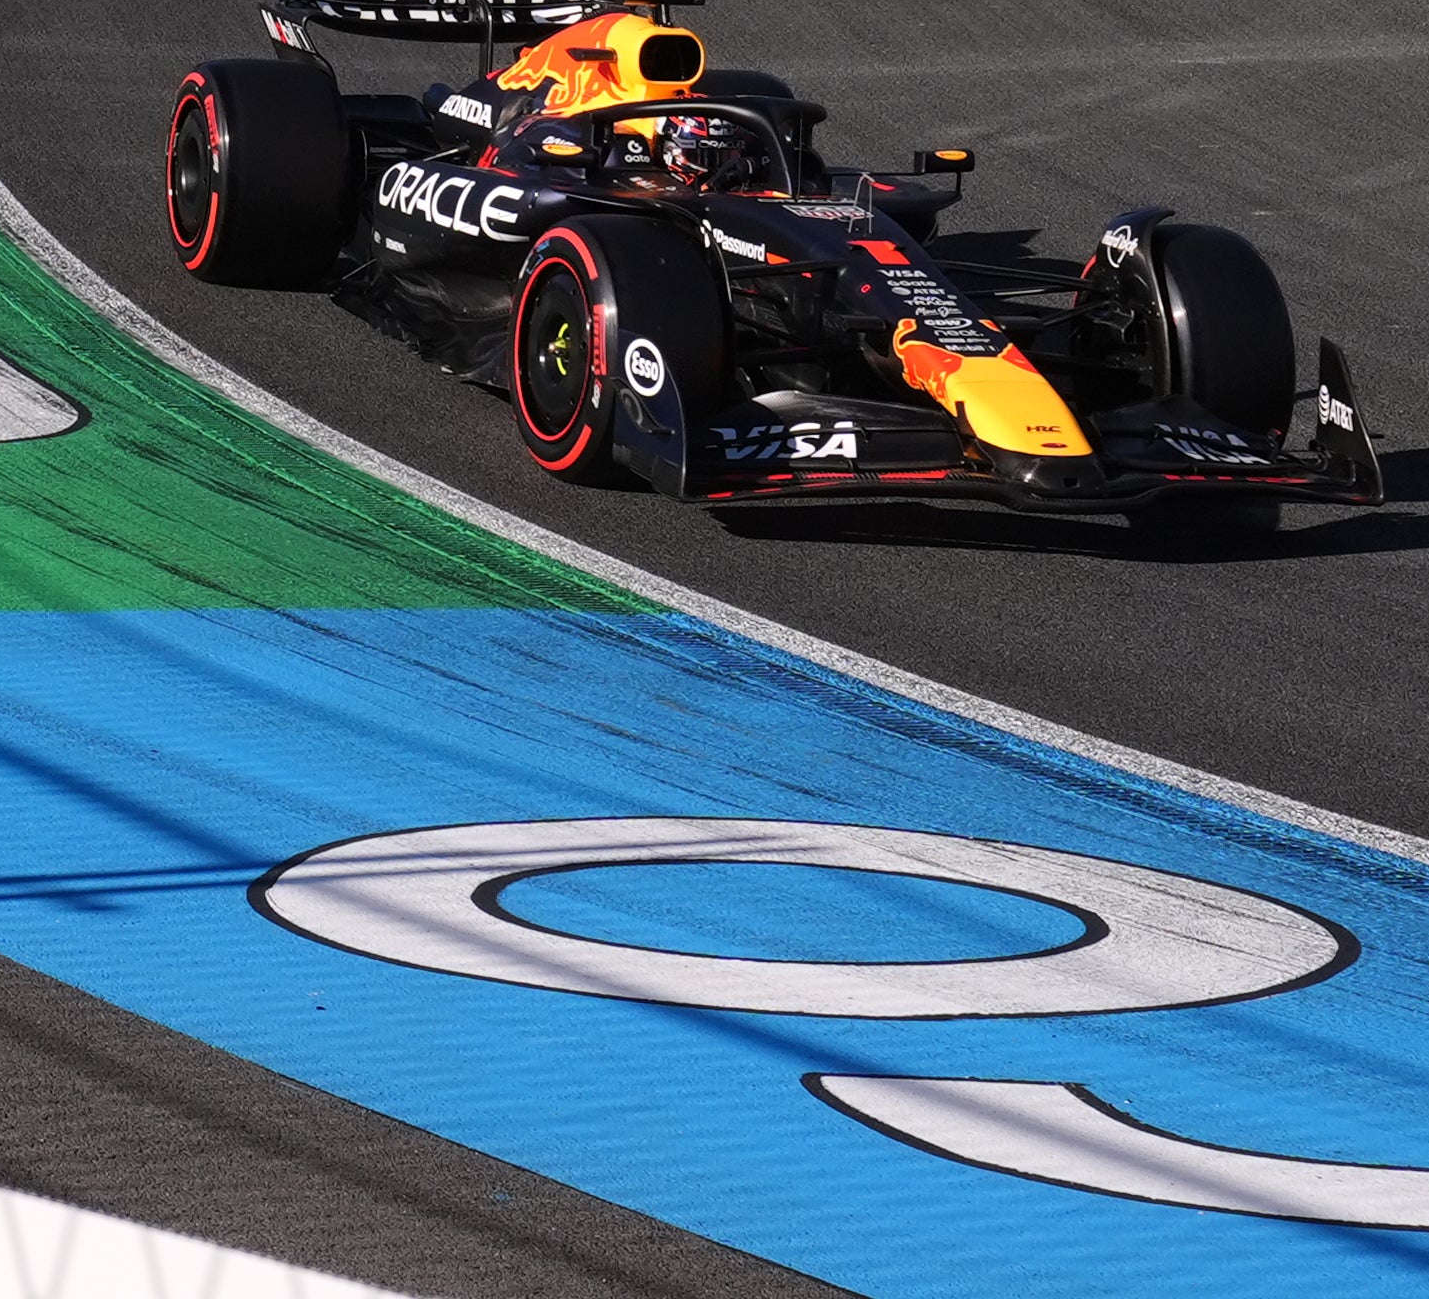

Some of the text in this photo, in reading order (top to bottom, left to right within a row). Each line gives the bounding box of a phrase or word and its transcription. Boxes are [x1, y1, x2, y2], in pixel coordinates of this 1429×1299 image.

[439, 94, 492, 129] HONDA
[624, 153, 651, 164] Gate
[378, 161, 531, 242] ORACLE
[877, 269, 928, 278] VISA
[924, 319, 961, 327] CDW
[945, 344, 986, 352] Mobil
[631, 350, 658, 382] Esso
[1329, 398, 1354, 432] AT&T
[709, 421, 858, 460] VISA
[1152, 422, 1272, 465] VISA
